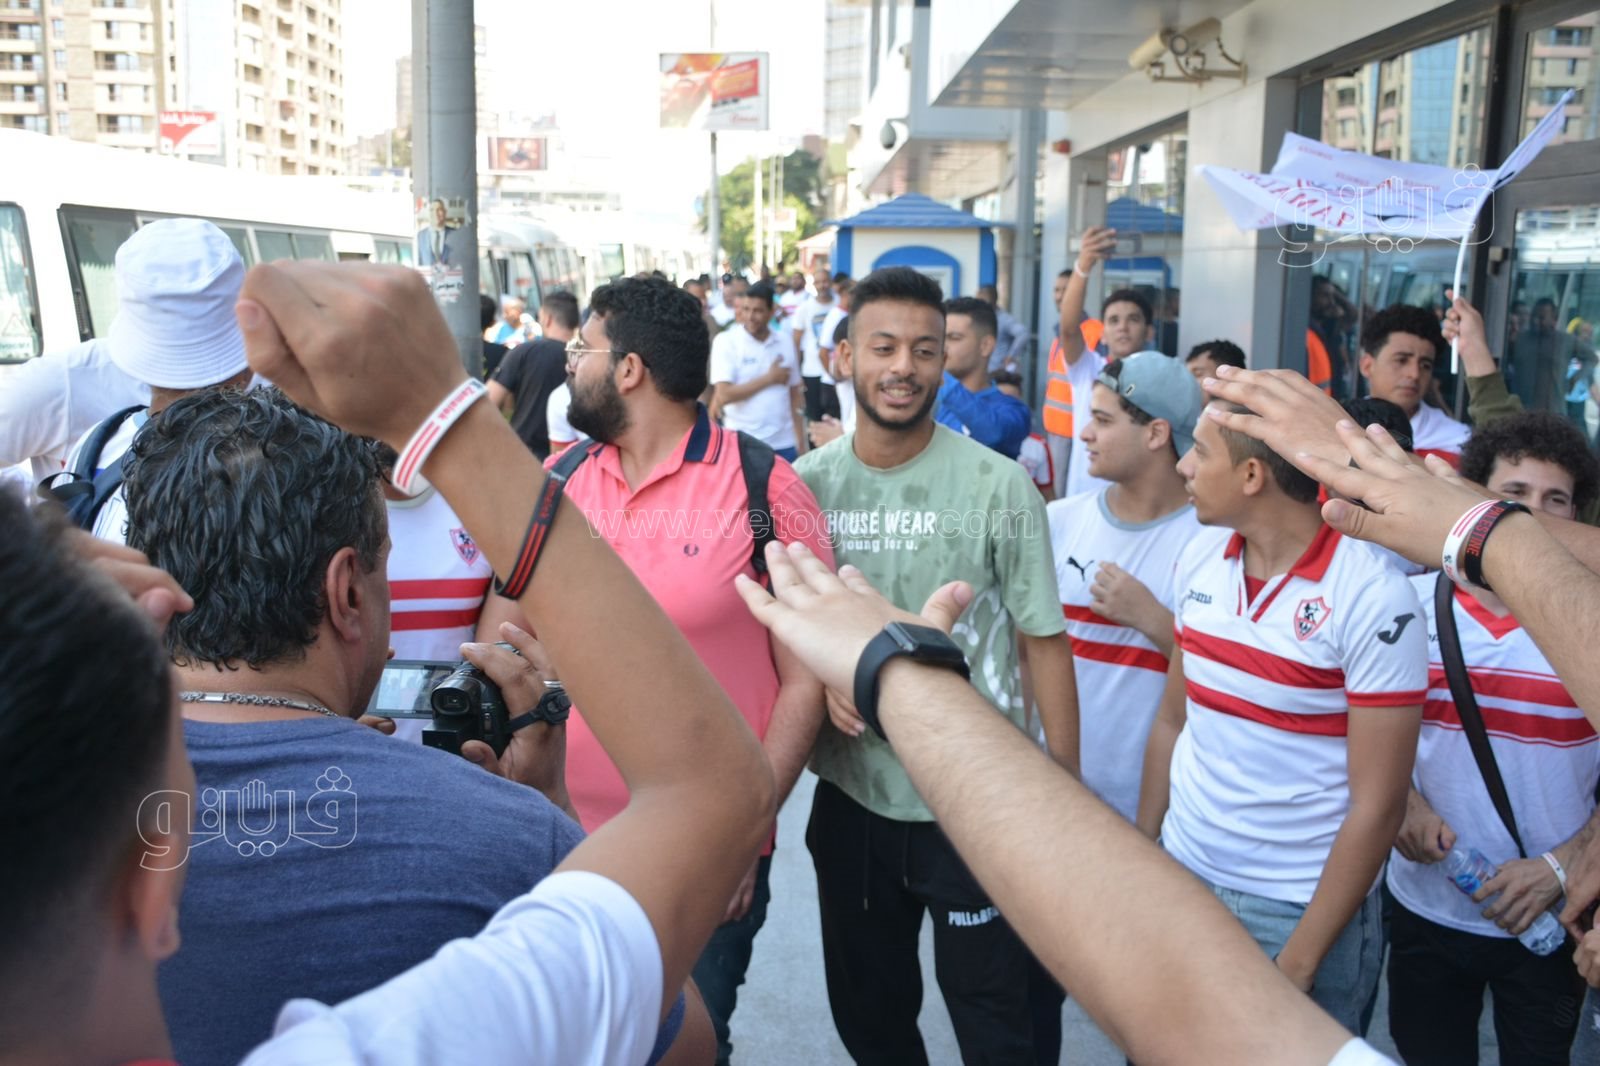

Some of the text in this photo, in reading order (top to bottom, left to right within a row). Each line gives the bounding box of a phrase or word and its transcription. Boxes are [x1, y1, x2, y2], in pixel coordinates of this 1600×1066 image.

[827, 510, 937, 535] HOUSE WEAR
[842, 539, 881, 553] young
[884, 537, 901, 550] for
